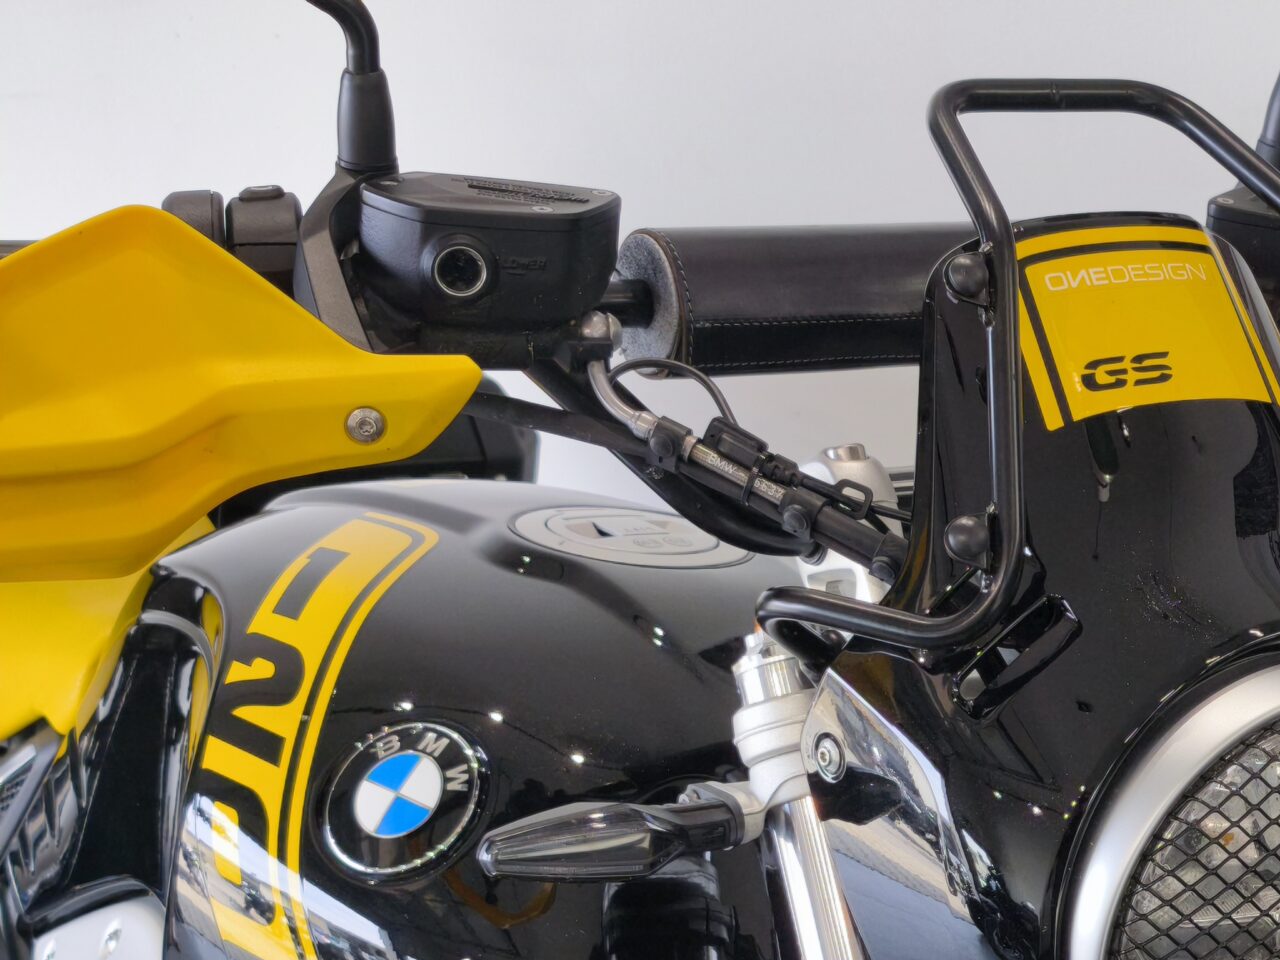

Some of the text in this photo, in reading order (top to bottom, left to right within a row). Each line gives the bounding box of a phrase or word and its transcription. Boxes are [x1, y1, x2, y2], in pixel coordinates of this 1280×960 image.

[1080, 351, 1173, 392] GS
[707, 453, 737, 475] BMW
[371, 732, 470, 792] BMW
